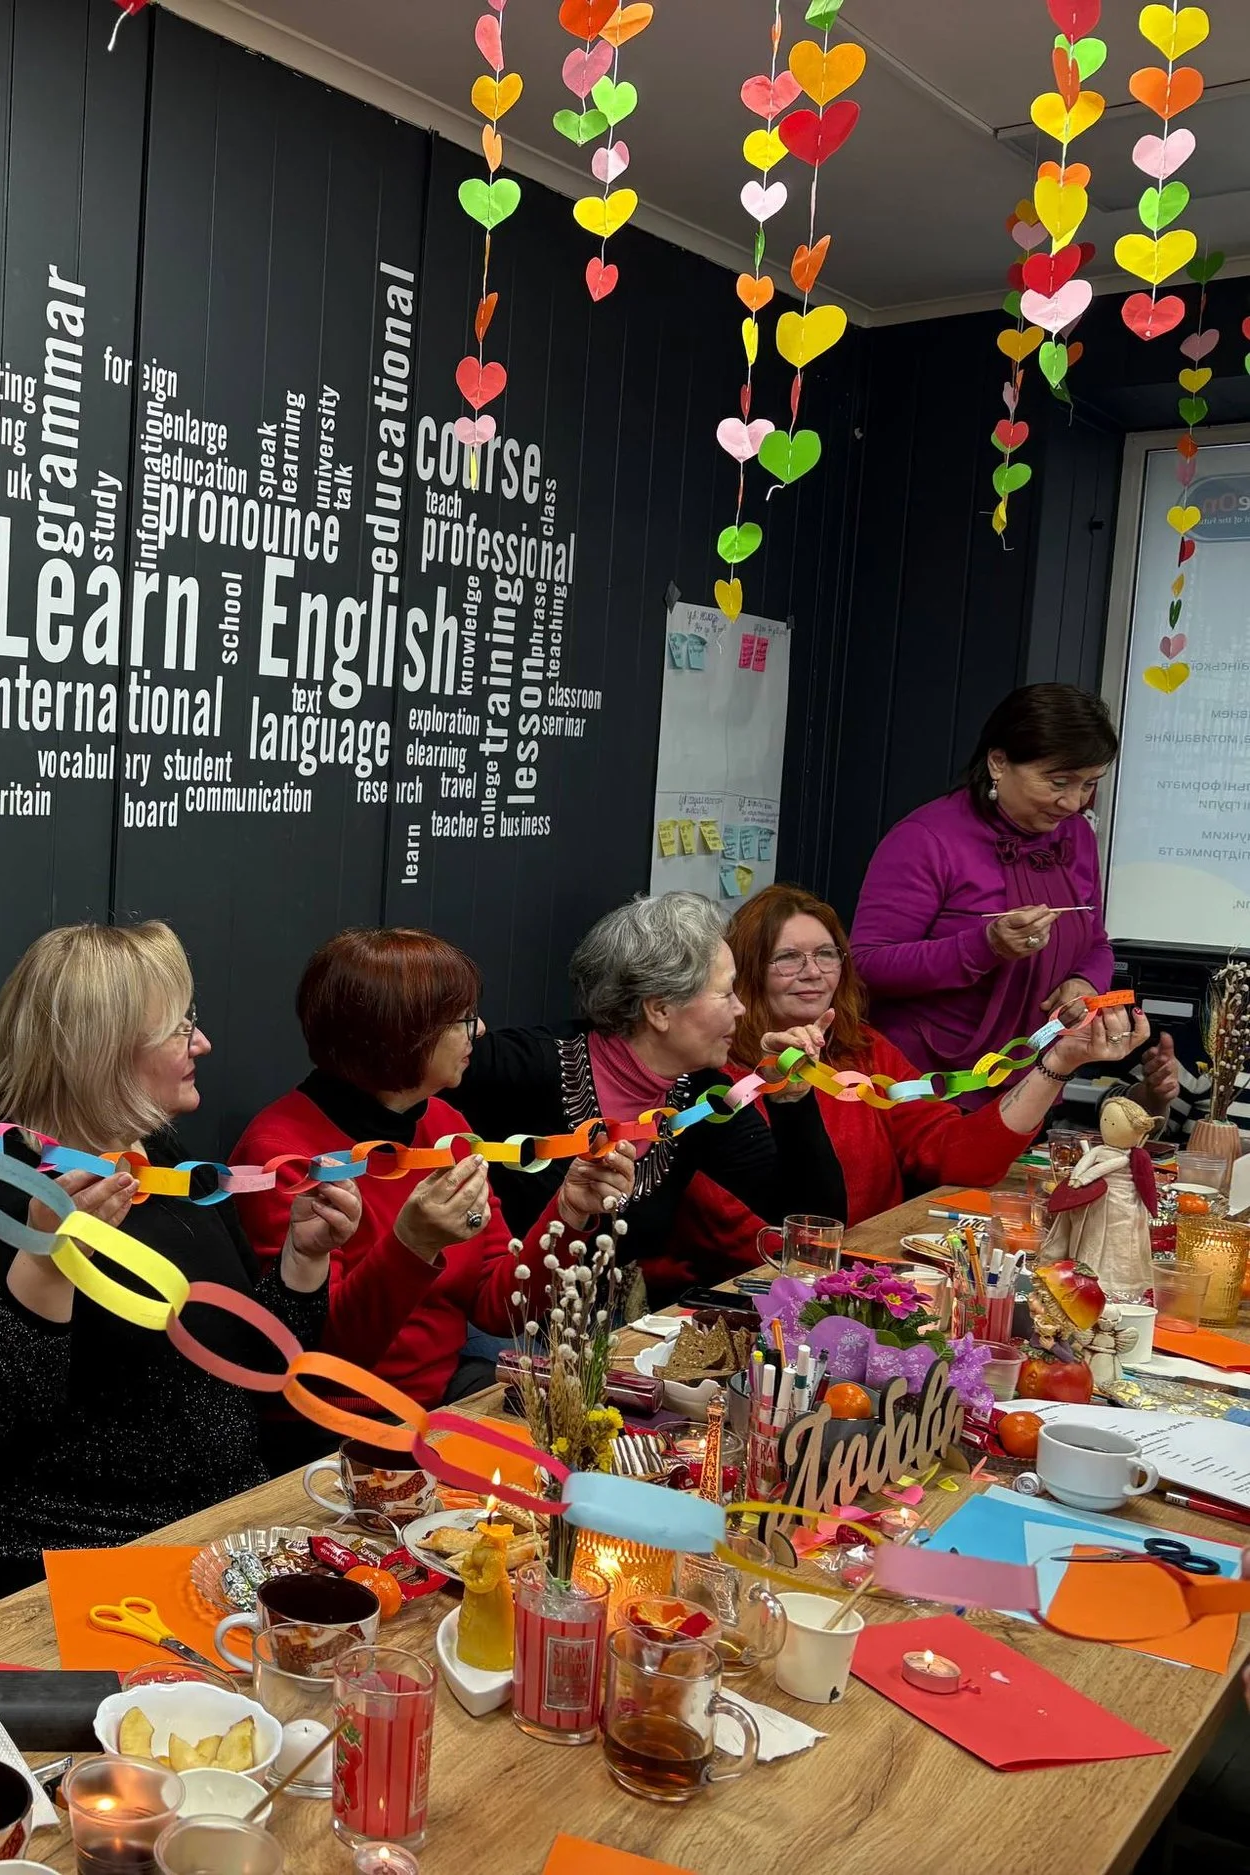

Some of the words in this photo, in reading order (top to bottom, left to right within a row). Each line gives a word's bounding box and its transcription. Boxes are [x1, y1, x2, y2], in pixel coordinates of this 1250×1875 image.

[36, 264, 86, 558] grammar
[163, 410, 227, 455] enlarge
[365, 262, 415, 573] educational
[161, 448, 248, 495] education
[258, 421, 278, 499] speak
[277, 390, 306, 503] learning
[314, 384, 340, 509] university
[415, 415, 542, 505] course
[6, 462, 33, 501] uk
[135, 398, 164, 572] information
[333, 463, 353, 510] talk
[425, 486, 462, 519] teach
[540, 478, 557, 537] class
[90, 471, 123, 563] study
[158, 482, 340, 564] pronounce
[421, 513, 576, 585] professional
[219, 571, 243, 665] school
[258, 556, 458, 709] English
[457, 575, 482, 696] knowledge
[529, 582, 547, 659] phrase
[546, 584, 568, 679] teaching
[479, 575, 523, 756] training
[548, 681, 602, 710] classroom
[292, 682, 322, 715] text
[409, 704, 480, 737] exploration
[541, 713, 586, 737] seminar
[250, 696, 391, 778] language
[406, 741, 467, 774] elearning
[507, 656, 546, 803] lesson
[163, 748, 233, 783] student
[440, 771, 476, 800] travel
[123, 793, 178, 829] board
[184, 781, 312, 814] communication
[431, 809, 478, 838] teacher
[481, 760, 500, 838] college
[499, 811, 551, 838] business
[401, 824, 421, 884] learn
[552, 1661, 588, 1679] BERRY
[553, 1642, 591, 1661] STRAW
